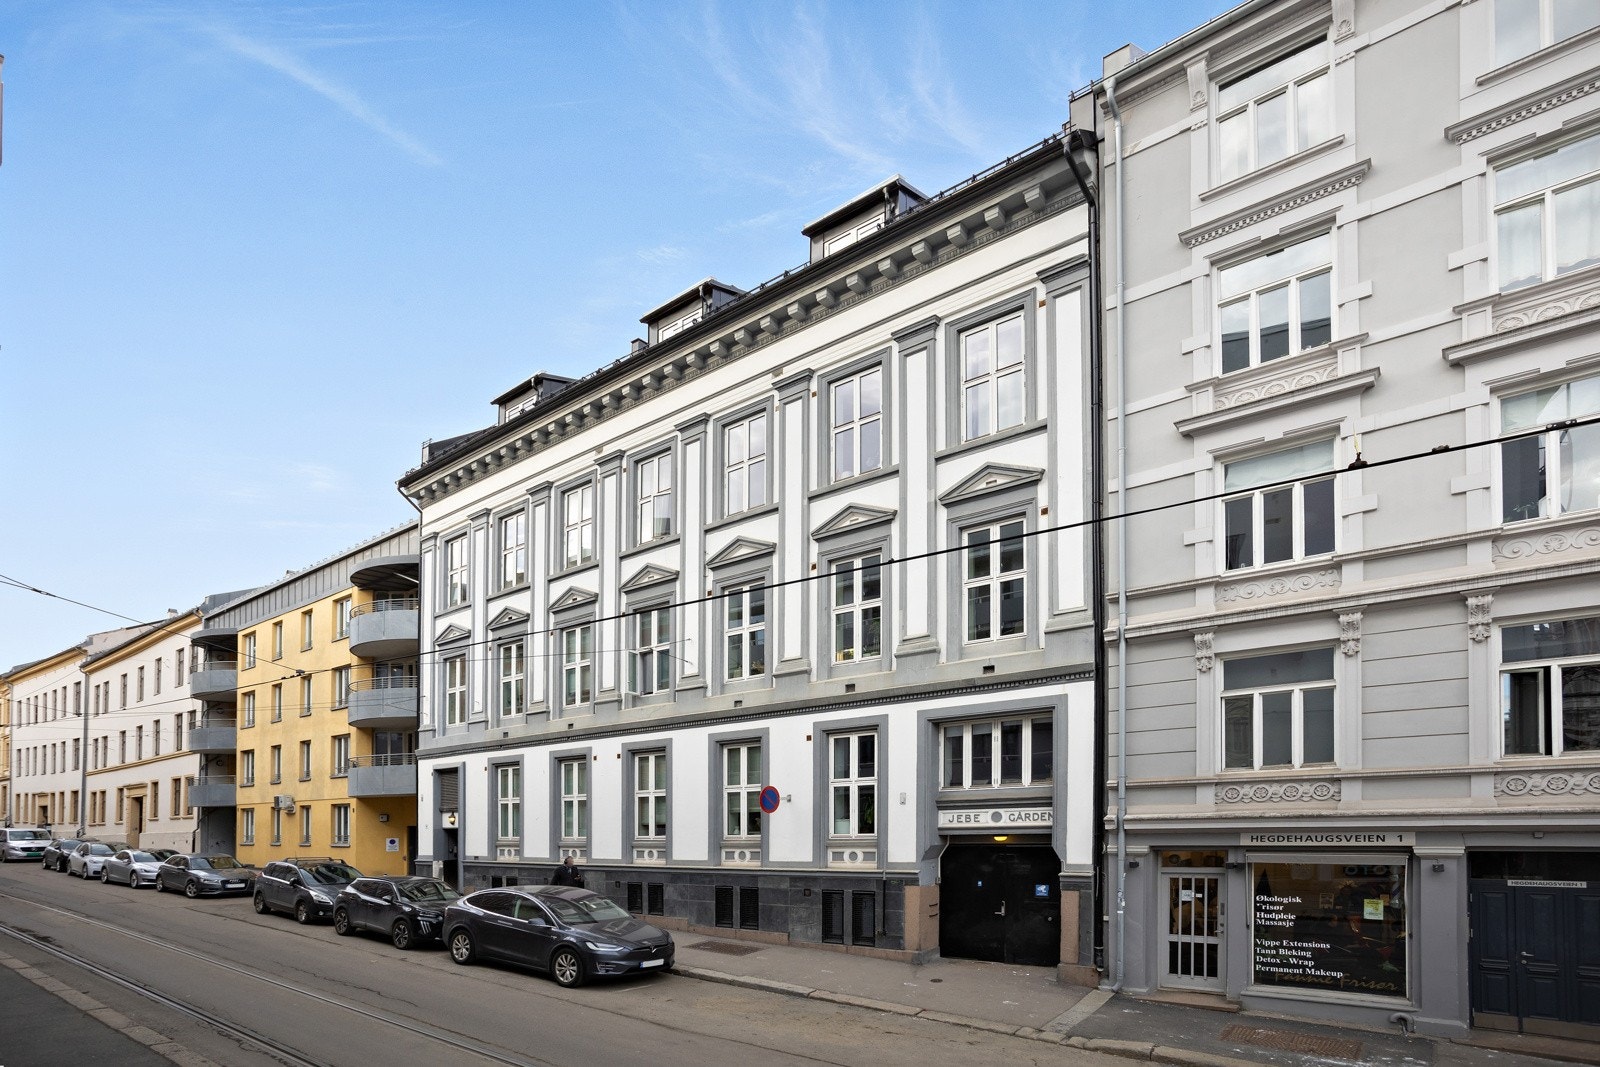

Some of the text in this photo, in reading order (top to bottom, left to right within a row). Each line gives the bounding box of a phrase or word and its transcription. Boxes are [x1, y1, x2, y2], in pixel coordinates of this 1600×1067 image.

[948, 813, 981, 823] JEBE
[1250, 834, 1403, 843] HEGDEHAUGSVEIEN 1
[1256, 894, 1302, 903] Økologisk
[1256, 903, 1284, 911] risør
[1256, 911, 1296, 920] Hudpleie
[1256, 918, 1295, 928] Massasje
[1255, 938, 1331, 949] Vippe Extensions
[1255, 947, 1312, 958] Tann Bleking
[1256, 955, 1281, 964] Detox
[1289, 957, 1315, 967] Wrap
[1256, 964, 1344, 978] Permanent Makeup
